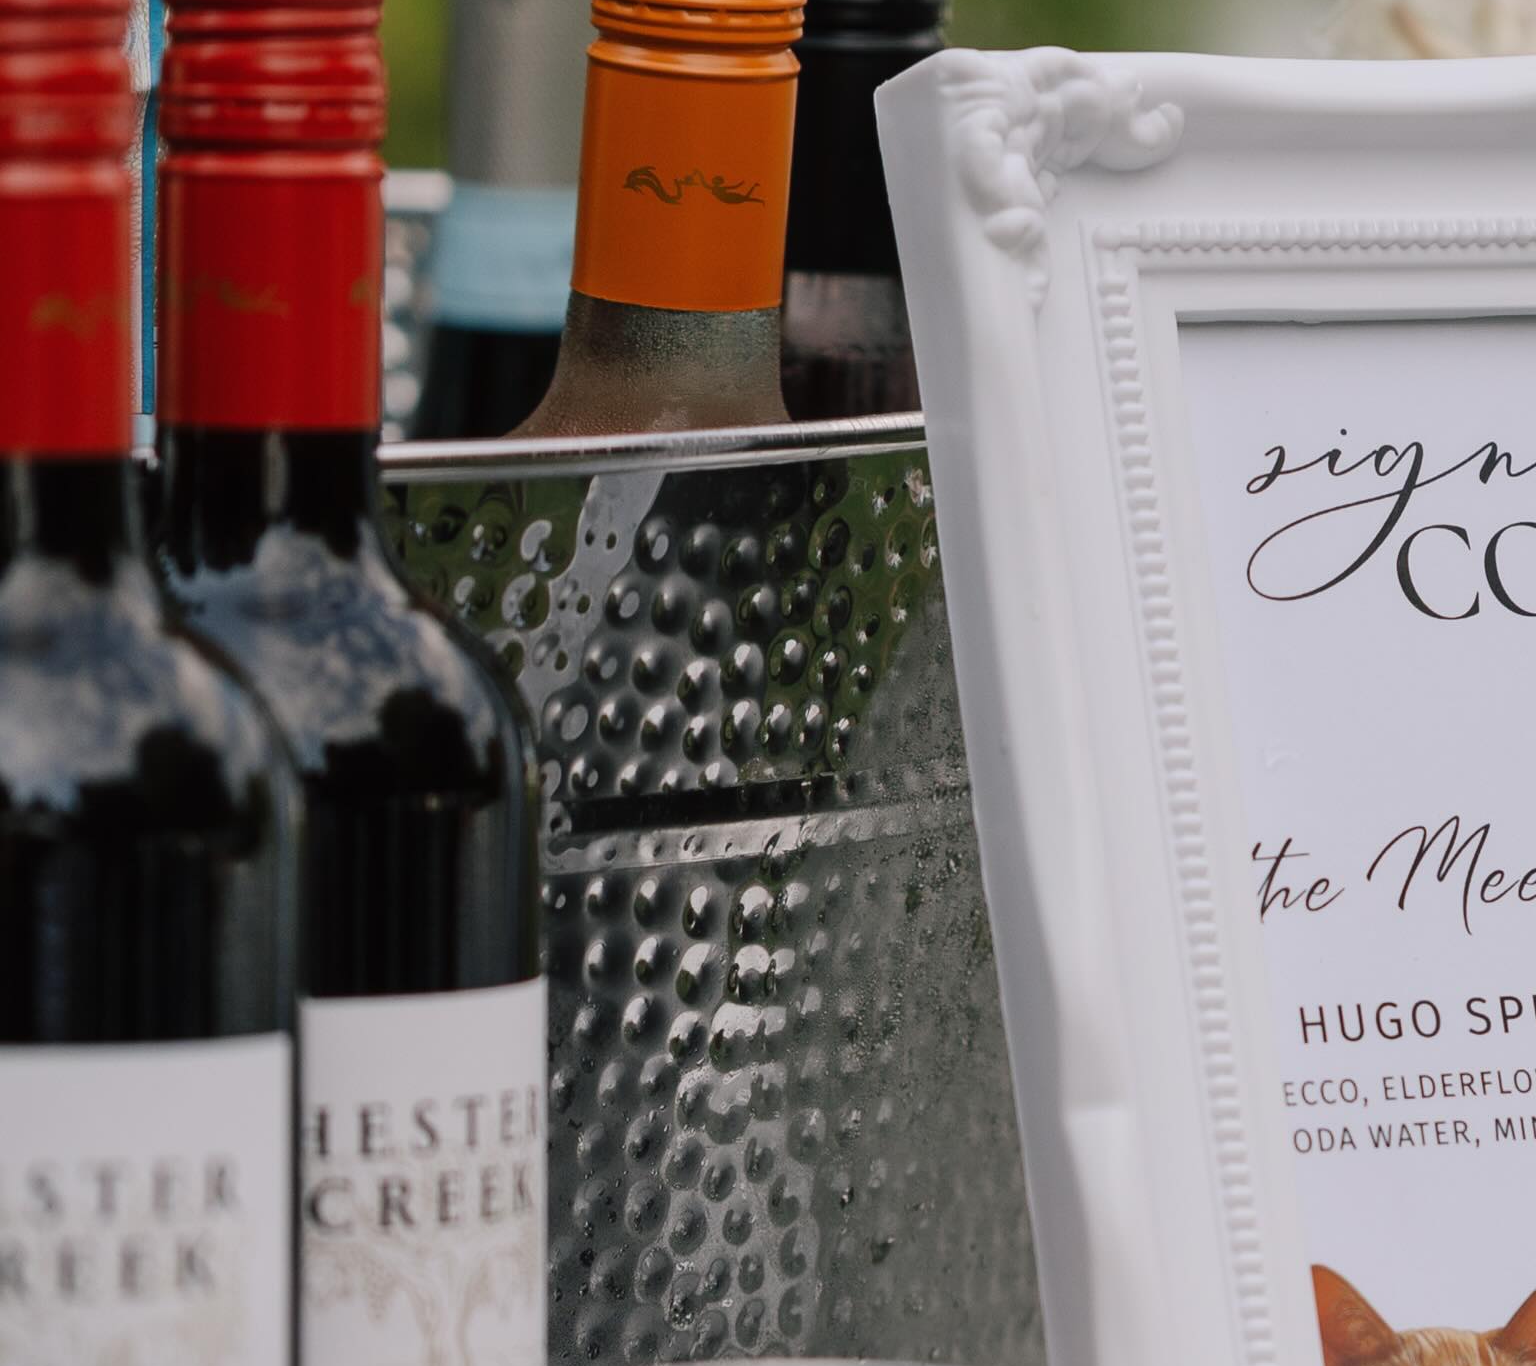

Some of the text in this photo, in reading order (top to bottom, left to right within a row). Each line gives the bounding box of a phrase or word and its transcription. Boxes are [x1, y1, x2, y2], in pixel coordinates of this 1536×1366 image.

[1299, 1000, 1441, 1044] HUGO
[1283, 1078, 1368, 1107] ECCO,
[1293, 1127, 1357, 1154] ODA
[1368, 1120, 1480, 1149] WATER,
